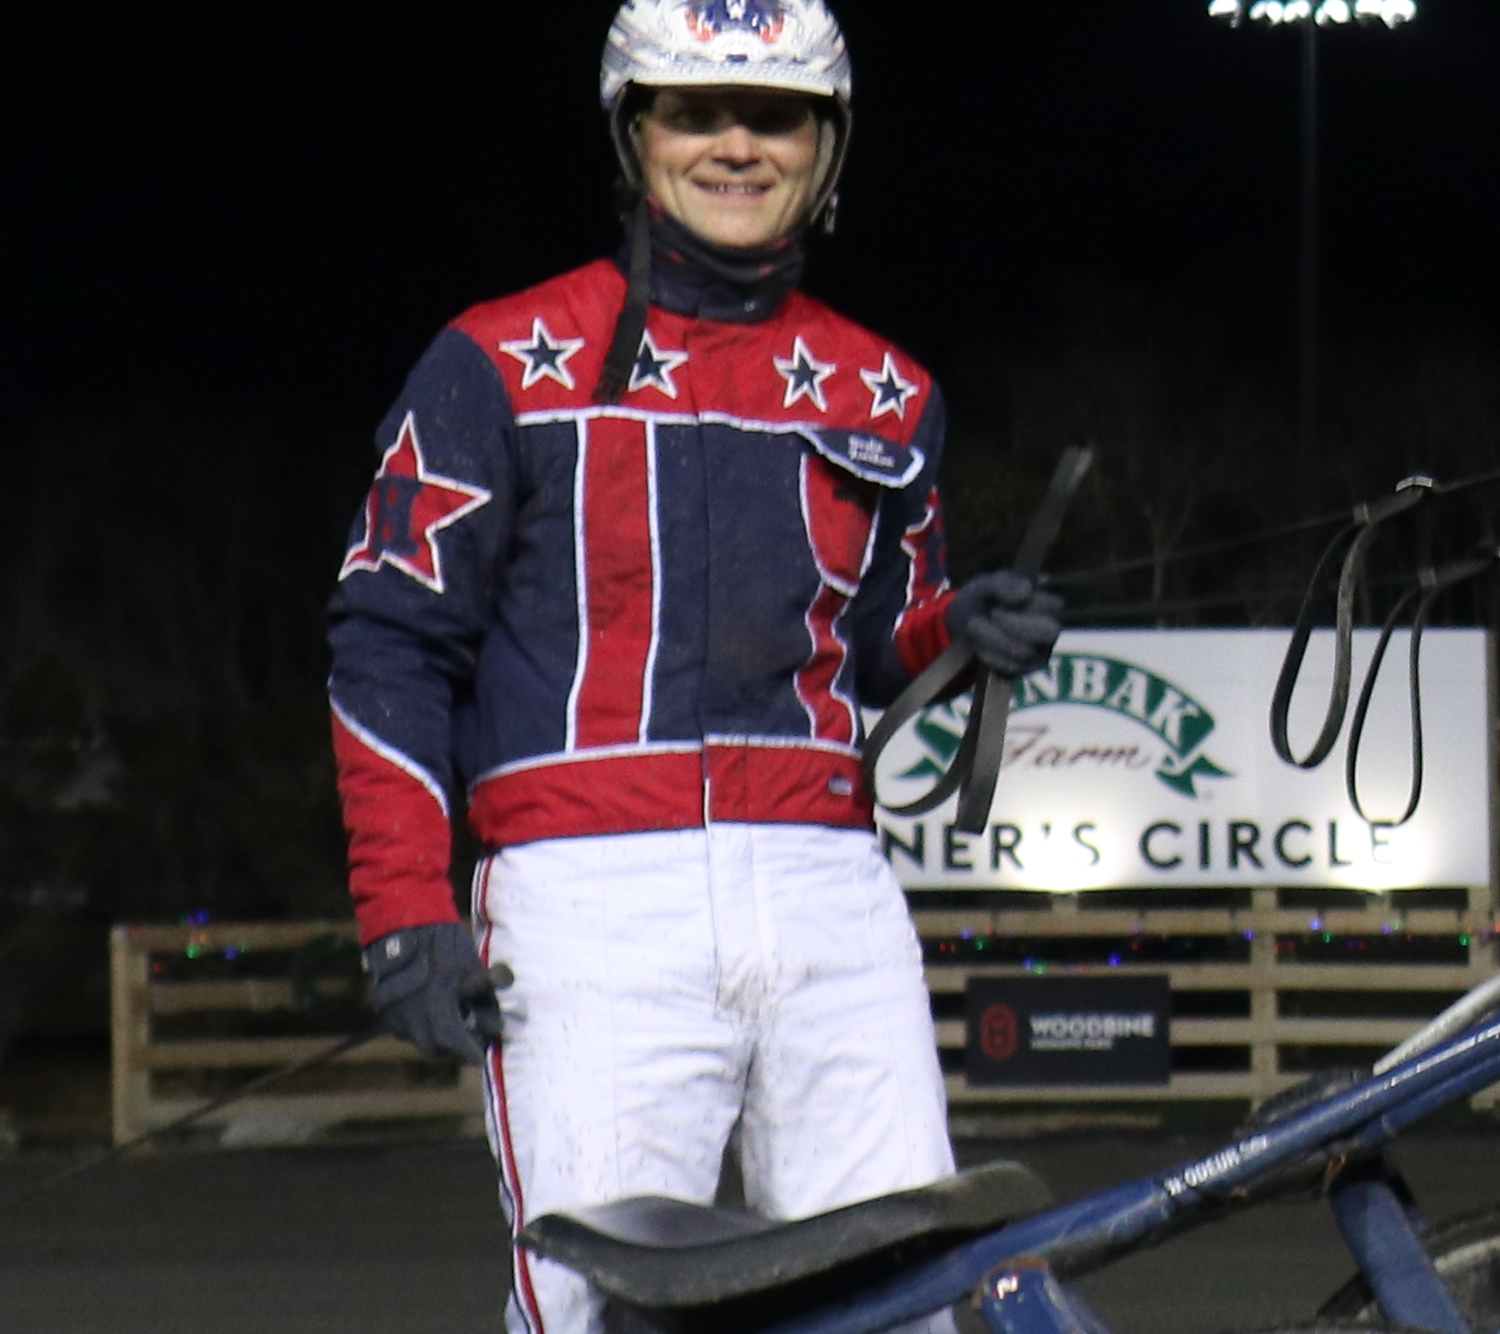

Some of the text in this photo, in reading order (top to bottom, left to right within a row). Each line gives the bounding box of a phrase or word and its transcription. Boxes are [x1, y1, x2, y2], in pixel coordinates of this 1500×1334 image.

[926, 658, 1200, 753] WNBAK
[1003, 724, 1150, 766] Farm
[1139, 821, 1396, 870] CIRCLE
